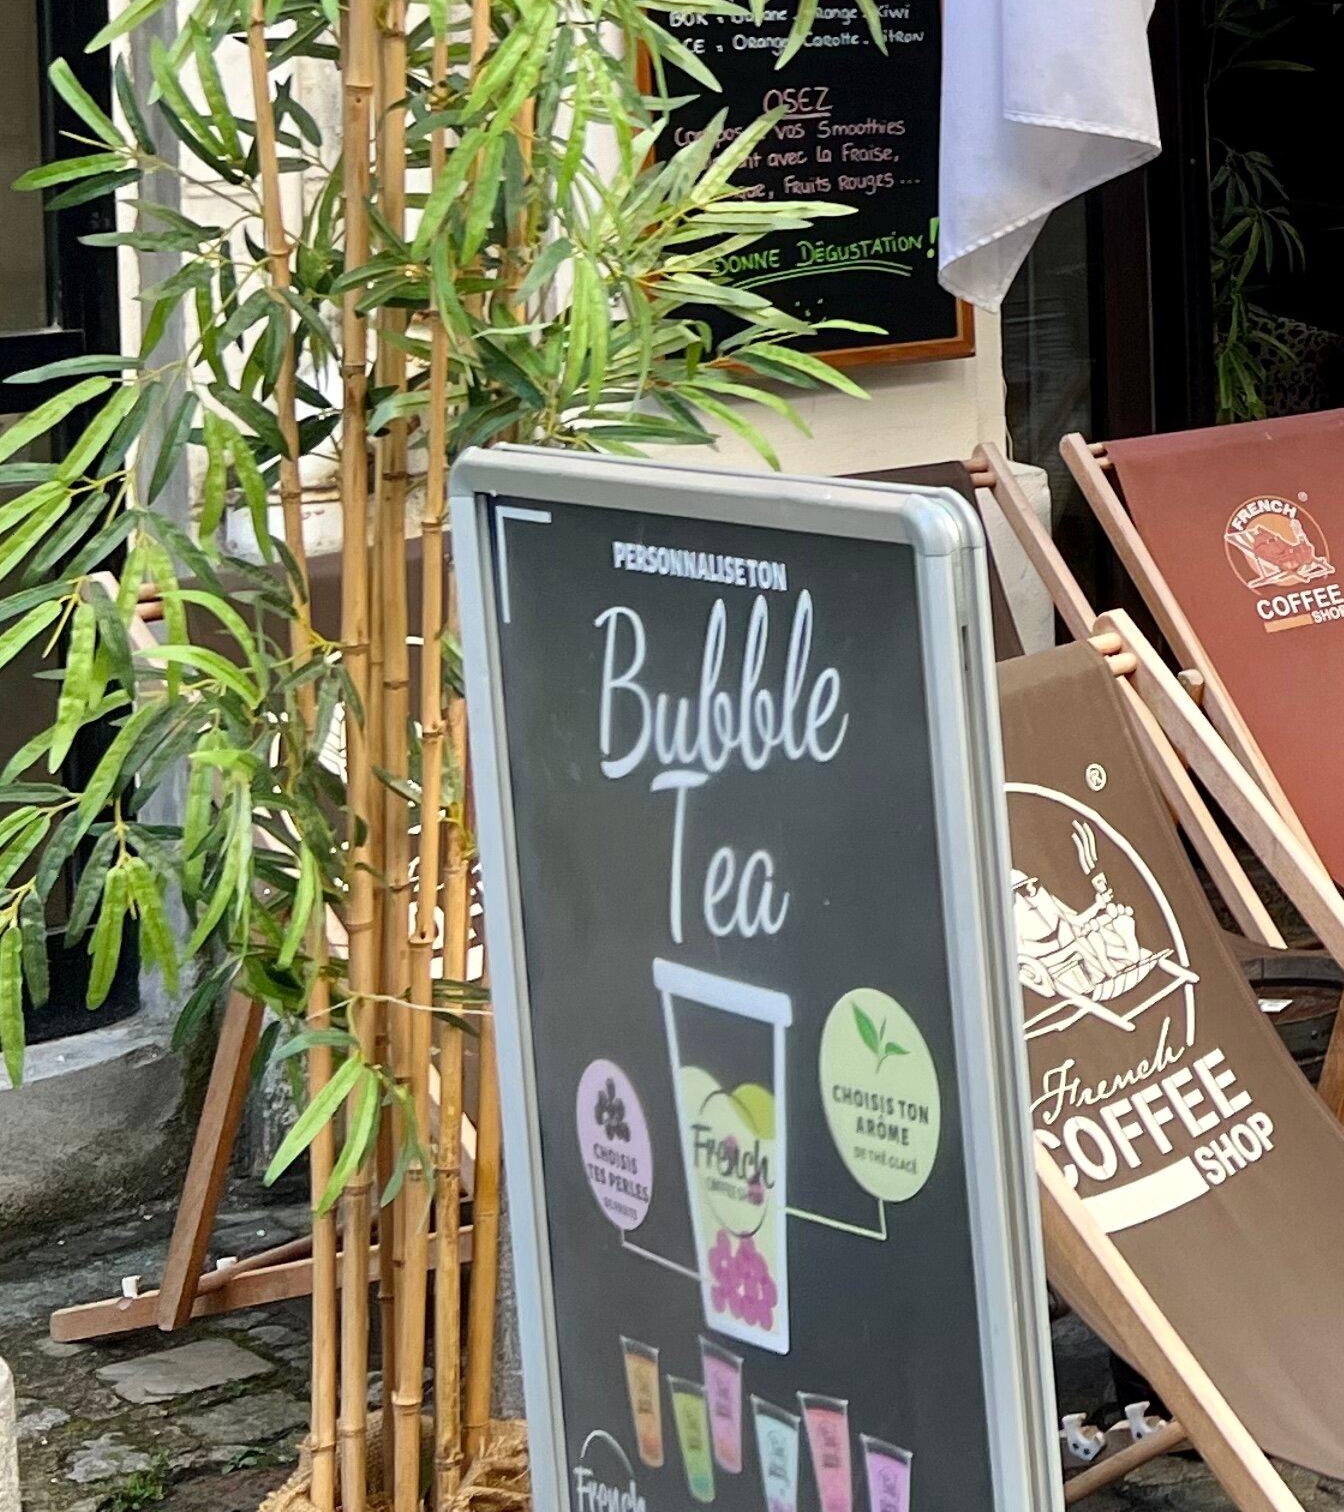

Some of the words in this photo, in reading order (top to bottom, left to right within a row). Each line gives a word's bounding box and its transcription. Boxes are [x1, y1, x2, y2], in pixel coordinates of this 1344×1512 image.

[763, 86, 833, 114] OSEZ
[767, 153, 808, 168] avec
[1231, 498, 1297, 531] FRENCH
[613, 541, 745, 586] PERSONNALISE
[744, 558, 788, 591] TON
[1256, 583, 1344, 620] COFFEE
[595, 589, 848, 778] Bubble
[650, 769, 791, 943] Tea
[1029, 1016, 1187, 1126] French
[832, 1084, 895, 1116] CHOISIS
[898, 1099, 930, 1125] TON
[593, 1143, 638, 1175] CHOISIS
[1194, 1110, 1275, 1187] SHOP
[587, 1163, 606, 1184] TES
[609, 1169, 649, 1203] PERLES
